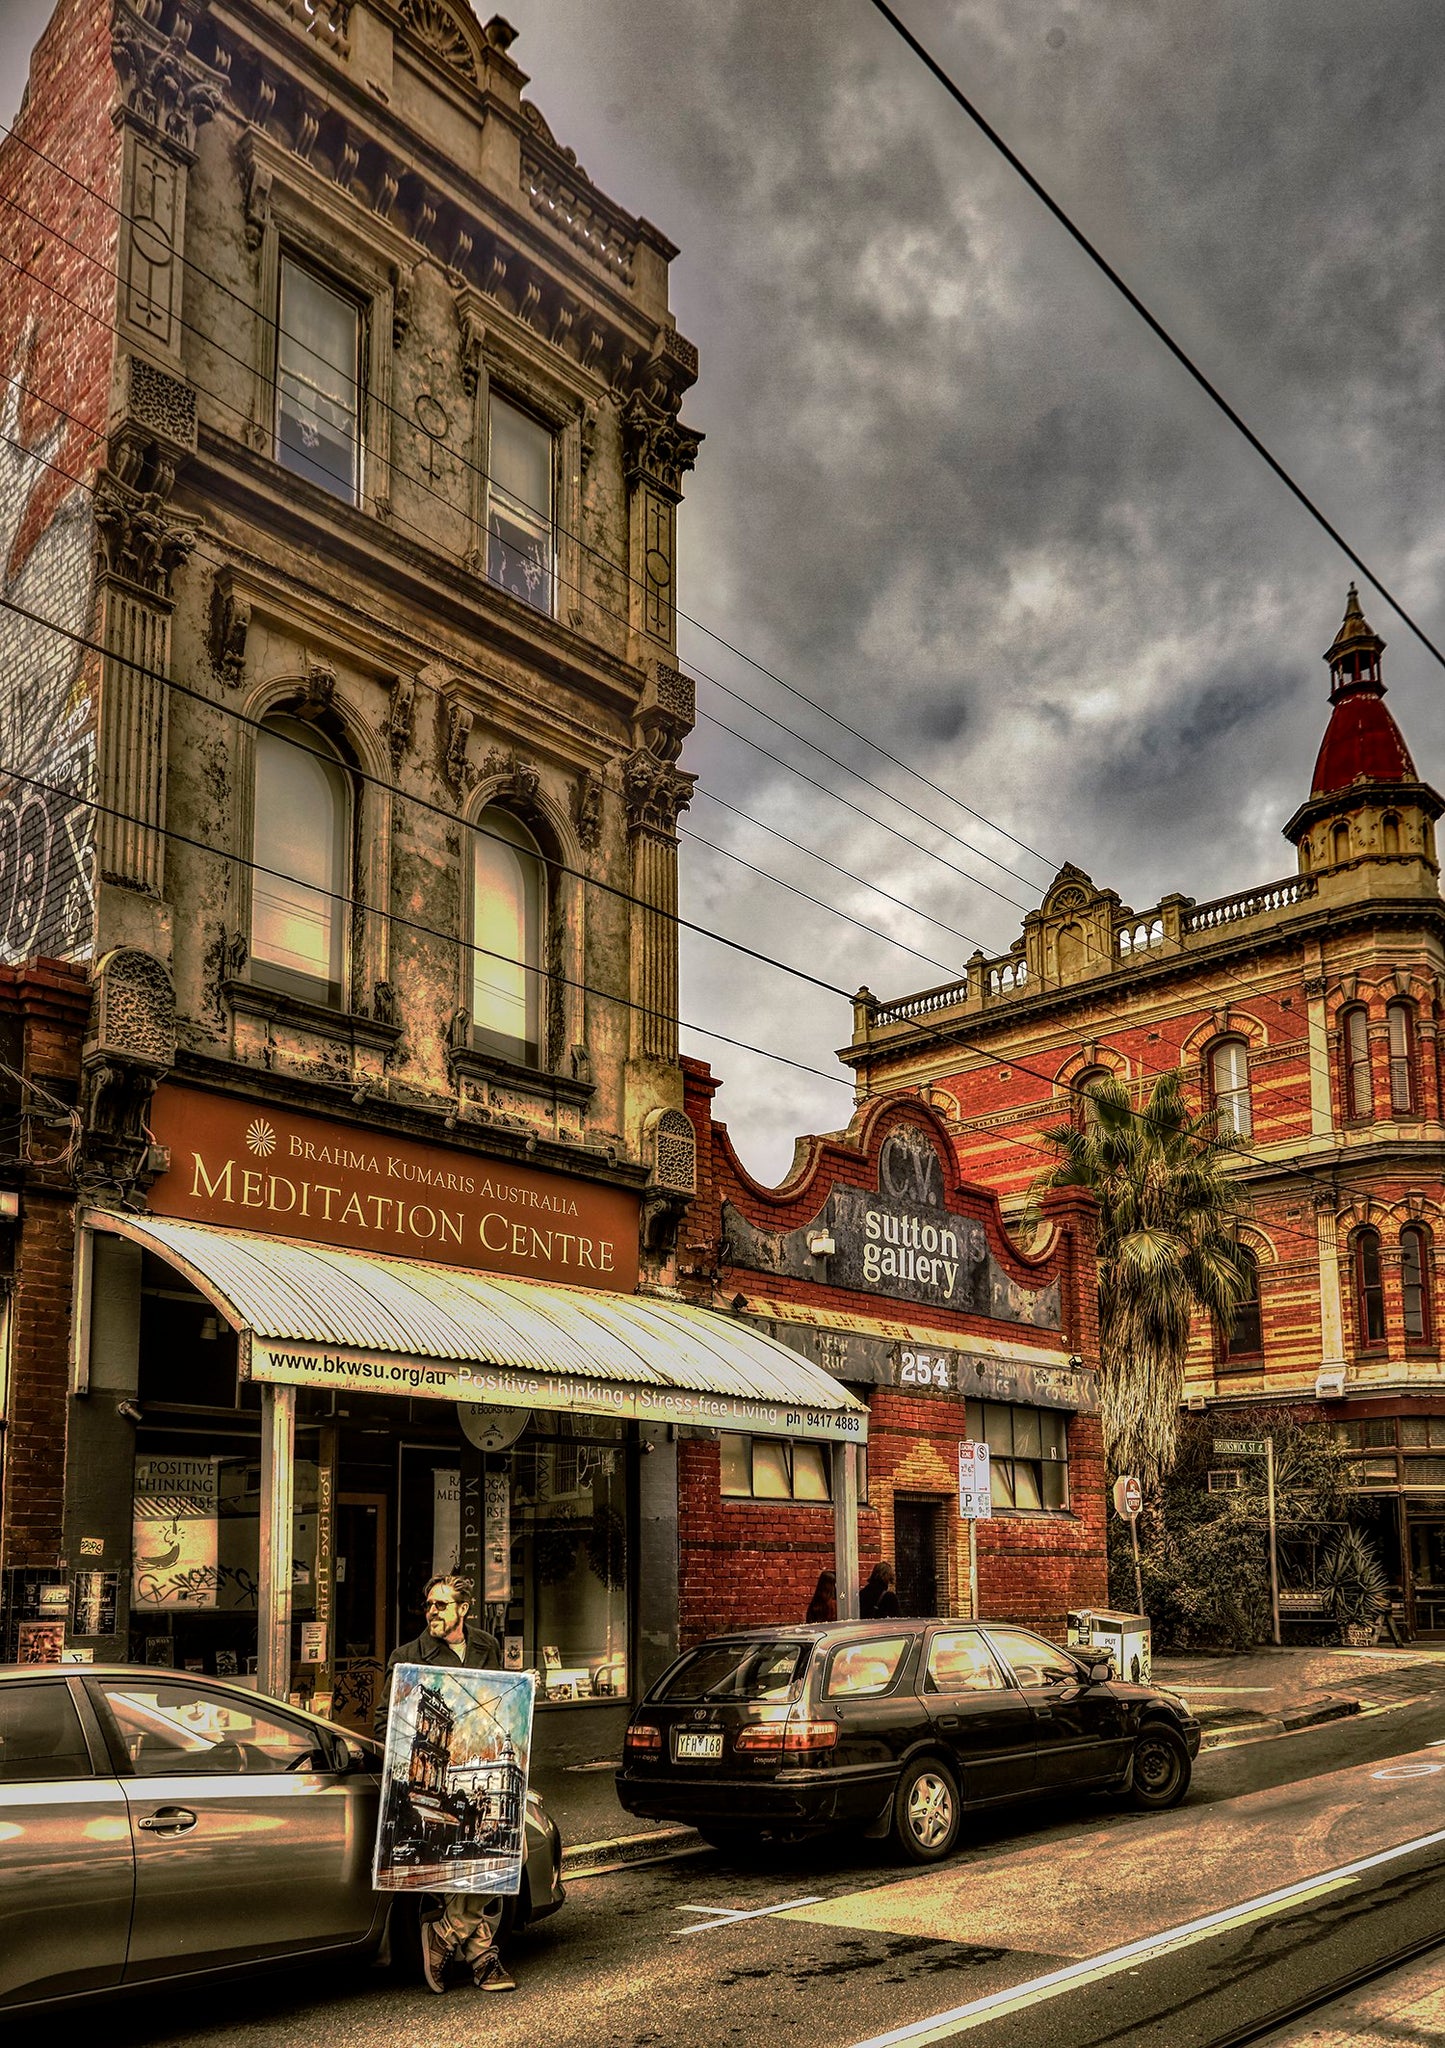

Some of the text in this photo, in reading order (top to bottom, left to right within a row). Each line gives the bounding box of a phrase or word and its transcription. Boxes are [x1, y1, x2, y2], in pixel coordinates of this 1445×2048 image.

[288, 1134, 579, 1217] BRAHMA KUMARIS AUSTRALIA
[188, 1151, 616, 1273] MEDITATION CENTRE
[865, 1210, 959, 1259] sutton
[862, 1242, 960, 1299] gallery
[901, 1352, 949, 1387] 254
[268, 1352, 860, 1432] www.bkwsu.org/au Positive Thinking Stress-free Living ph 9417 4883
[135, 1477, 214, 1493] THINKING
[149, 1461, 214, 1476] POSITIVE
[155, 1494, 215, 1510] COURSE
[680, 1737, 721, 1752] YFH 168
